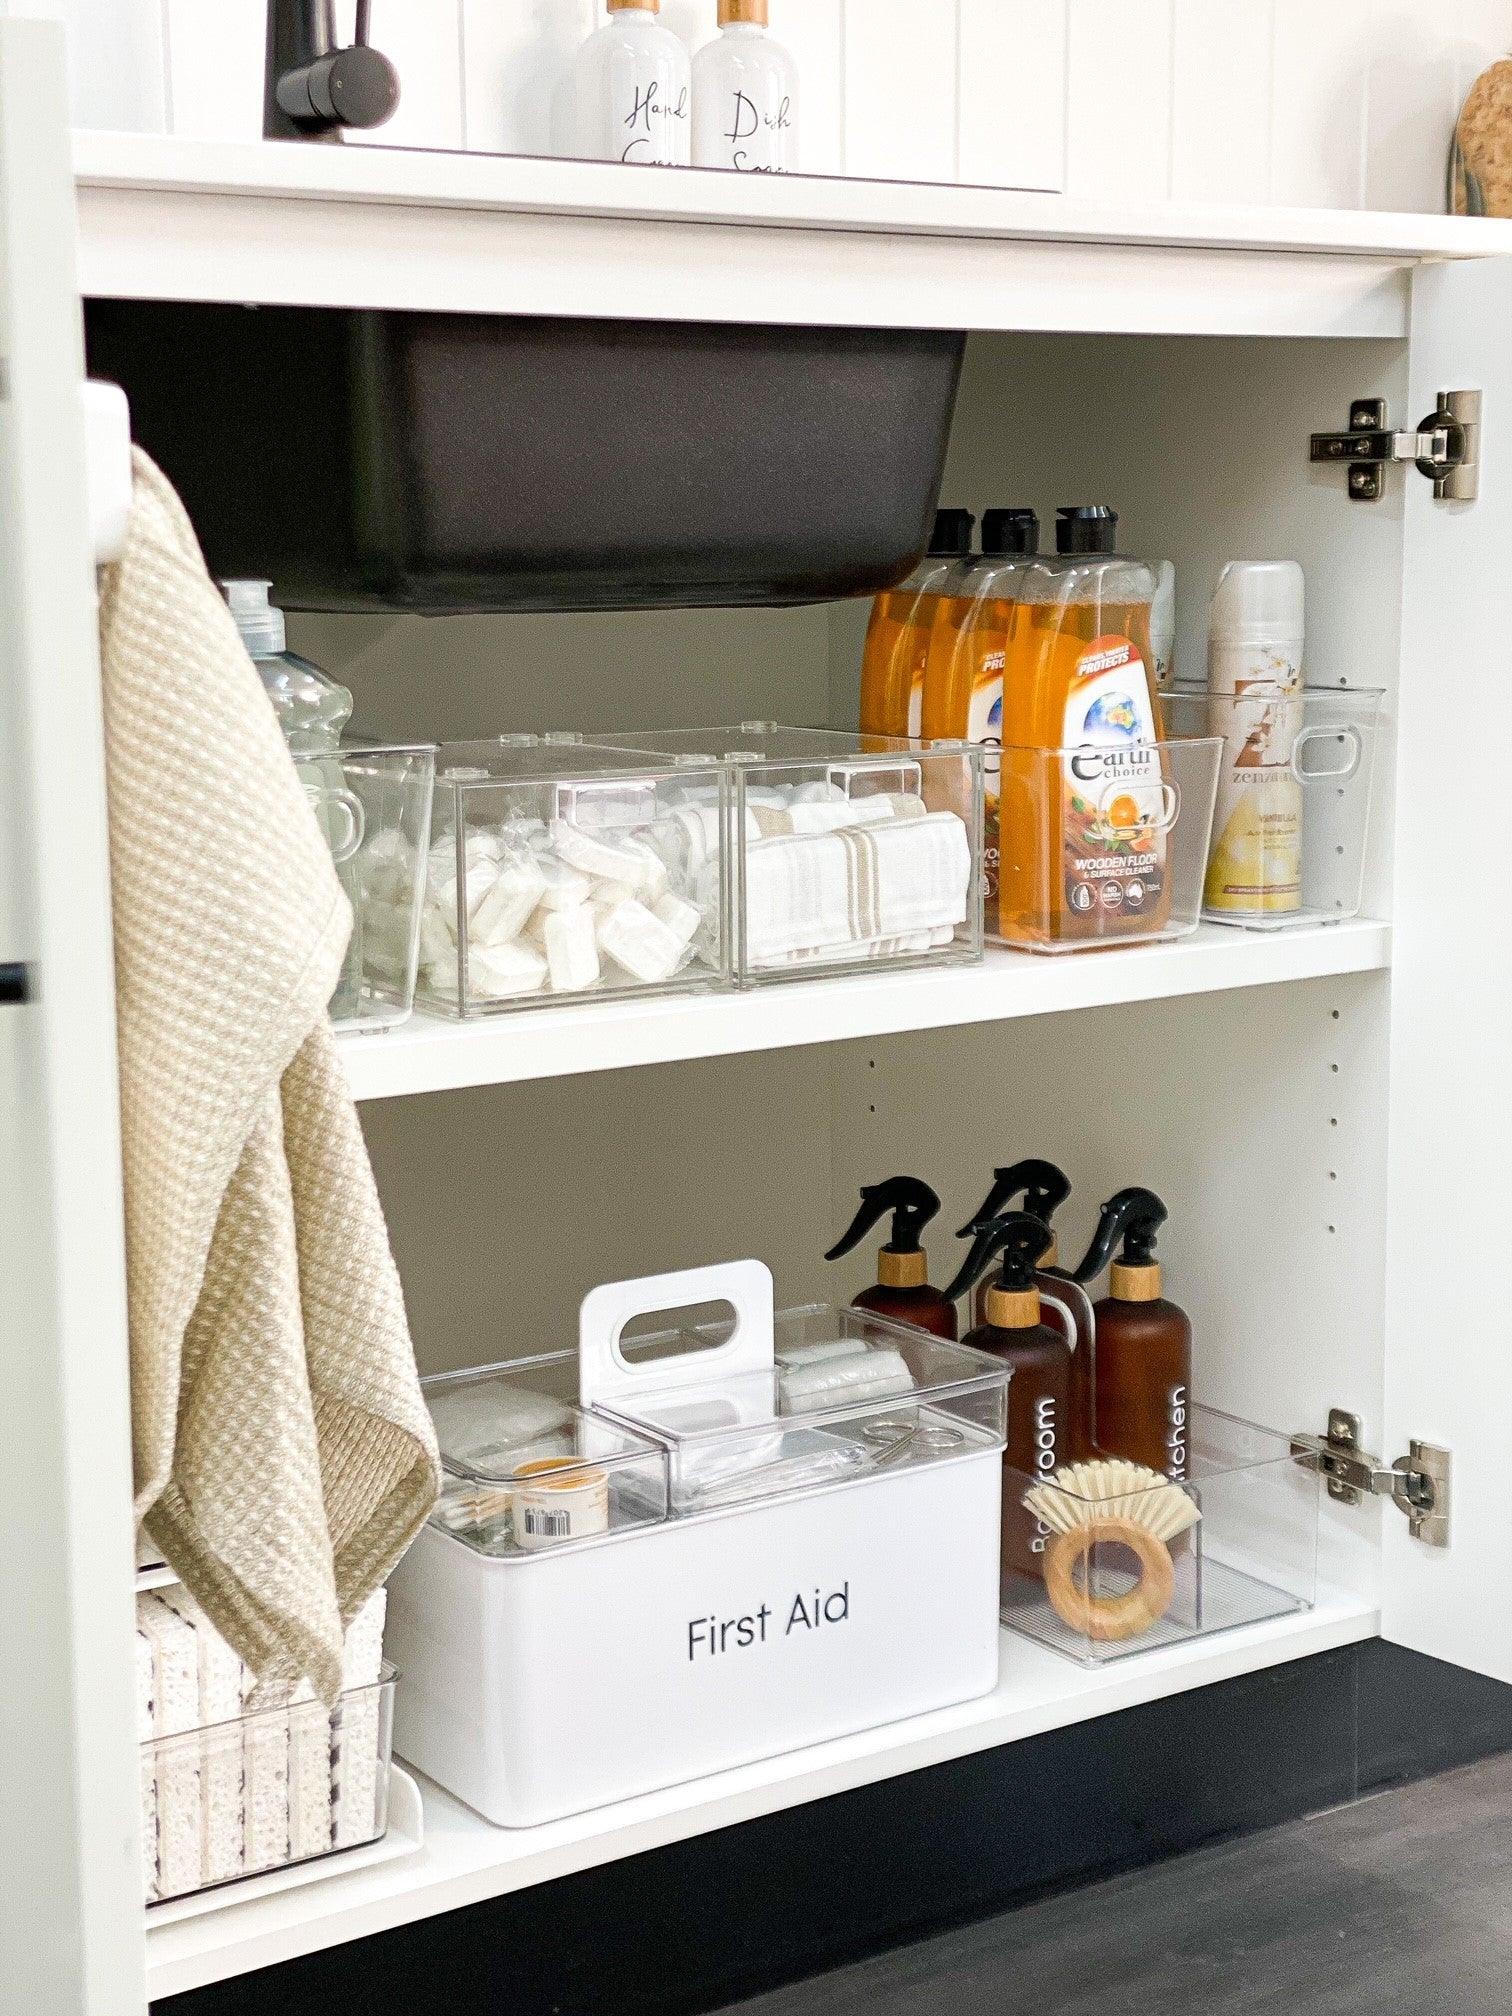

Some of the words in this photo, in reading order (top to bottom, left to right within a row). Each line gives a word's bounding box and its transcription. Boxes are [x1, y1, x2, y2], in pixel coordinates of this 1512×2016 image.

[624, 81, 687, 132] Hand
[1104, 765, 1151, 779] choice
[1075, 856, 1127, 870] WOODEN
[1127, 853, 1158, 867] FLOOR
[1090, 868, 1127, 878] SURFACE
[1126, 865, 1154, 876] CLEANER
[688, 1603, 772, 1661] First
[785, 1581, 849, 1636] Aid
